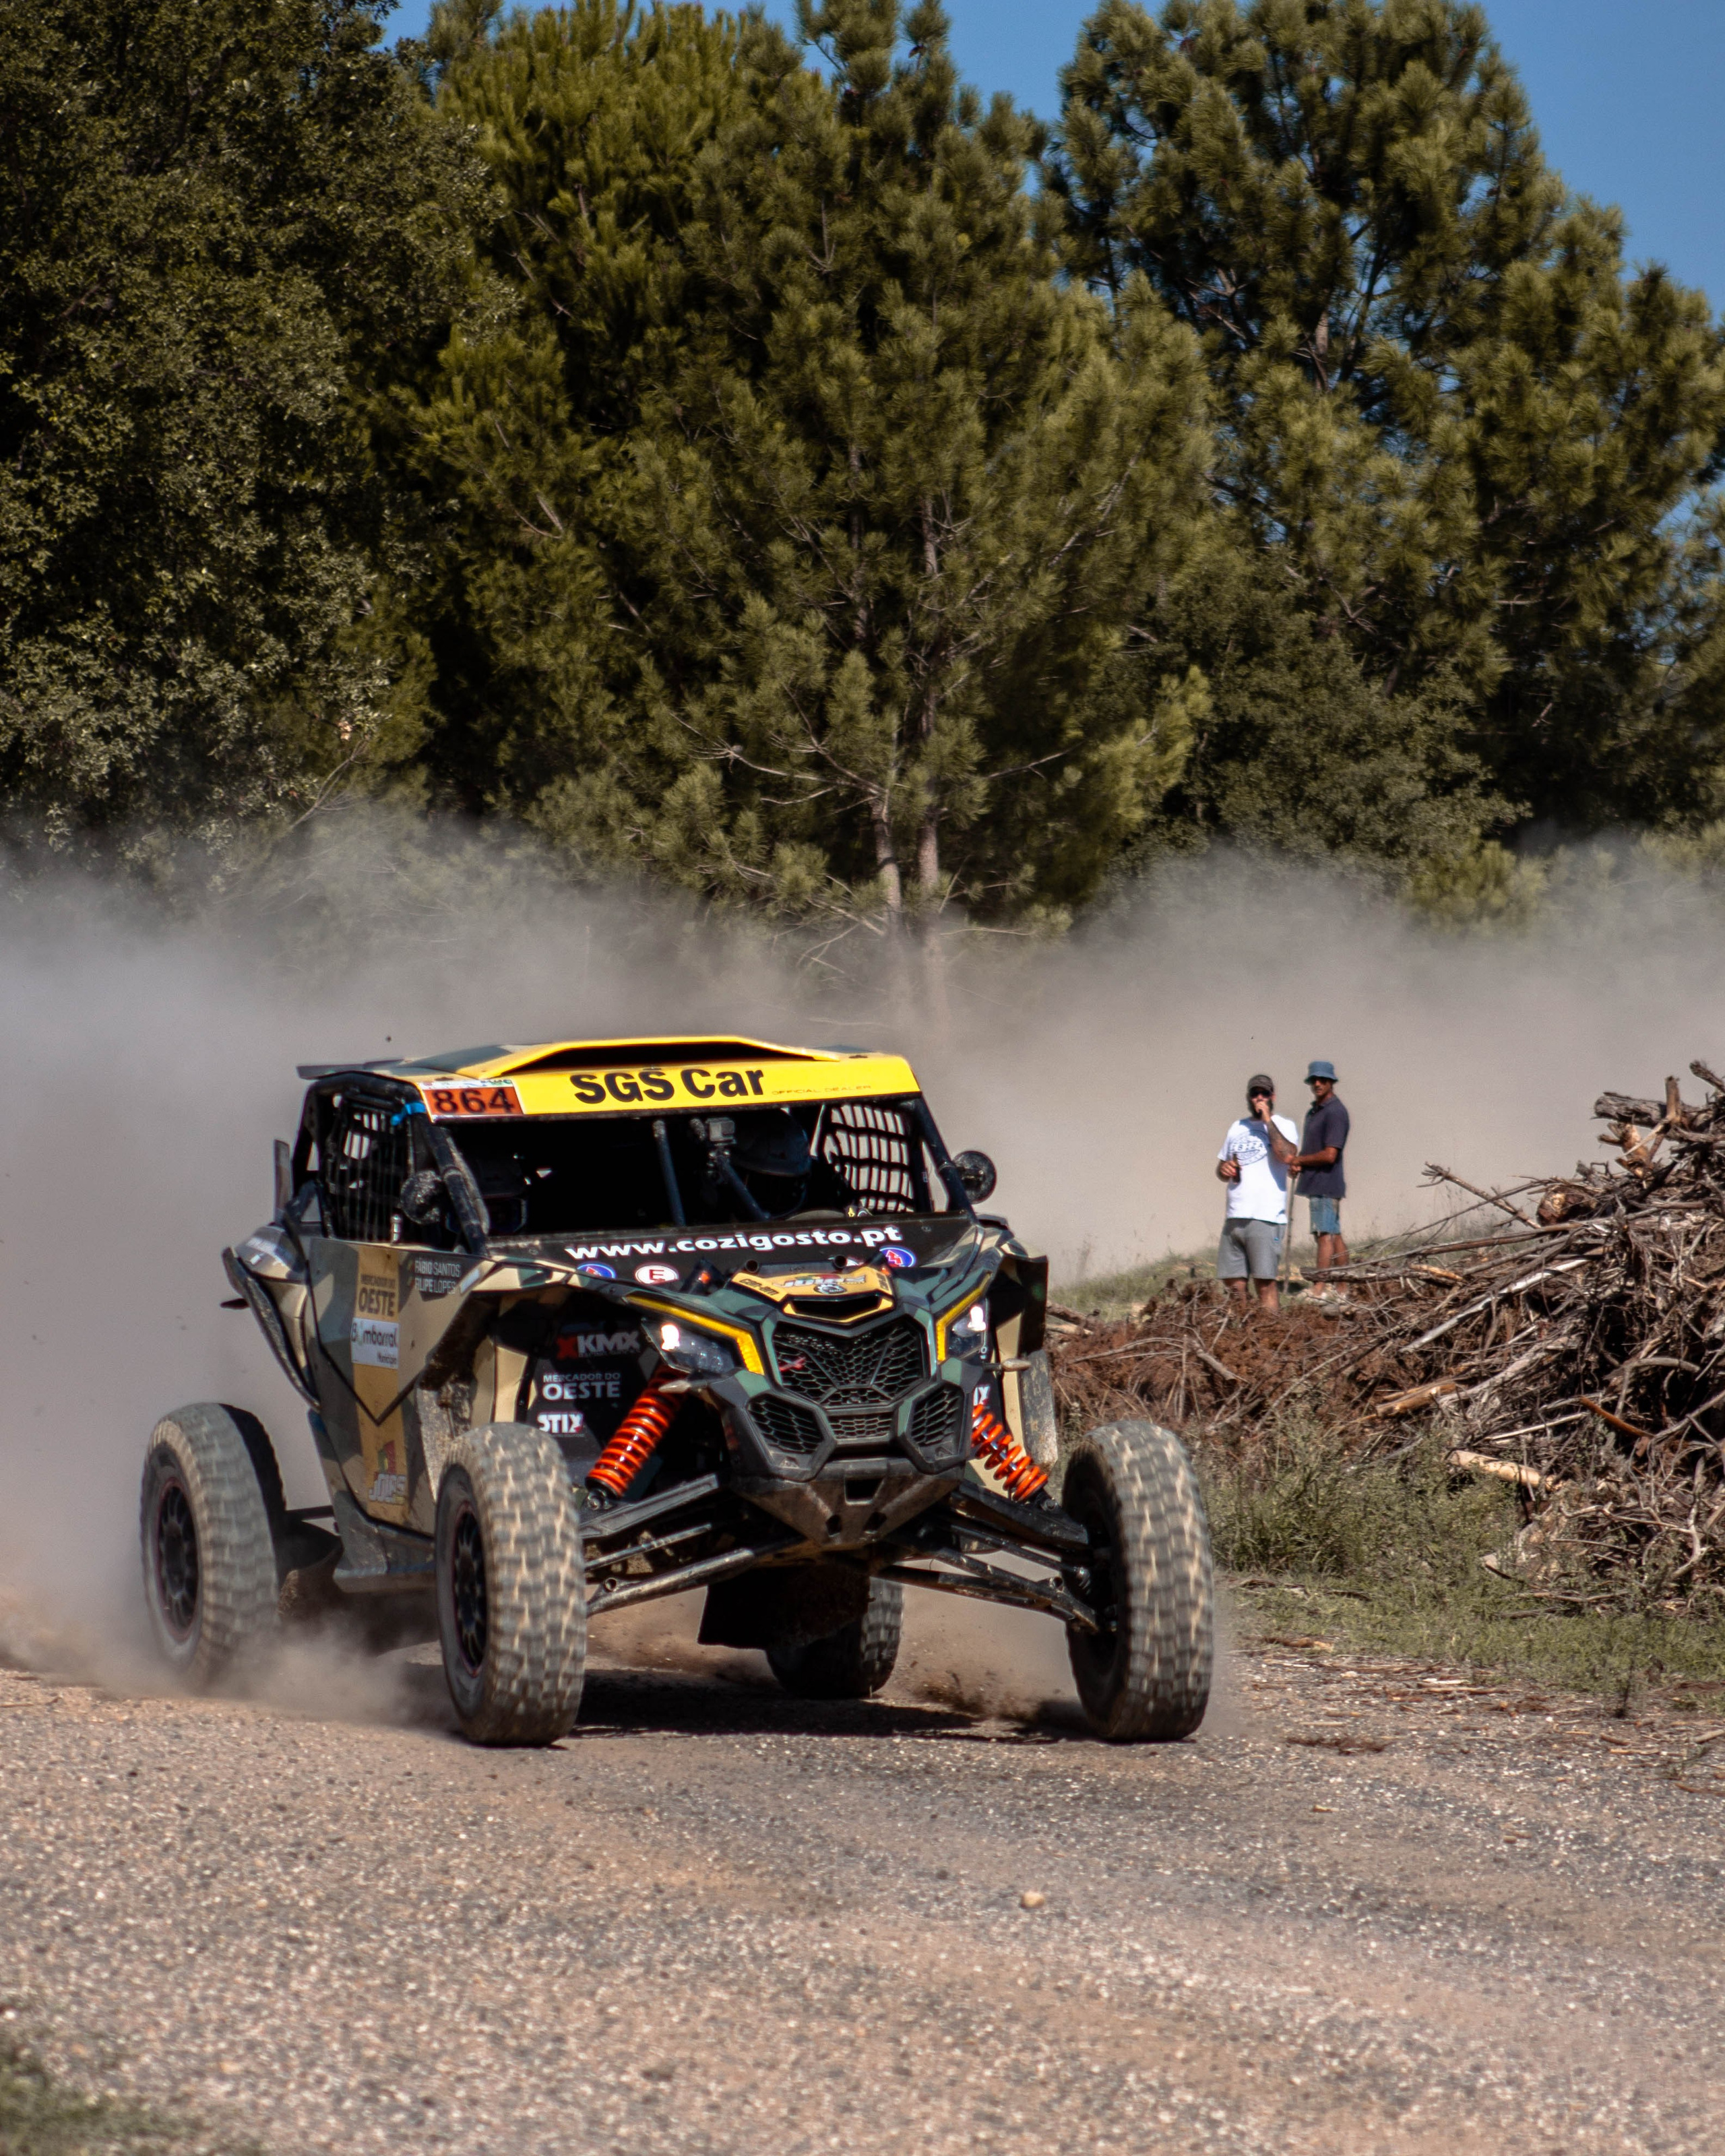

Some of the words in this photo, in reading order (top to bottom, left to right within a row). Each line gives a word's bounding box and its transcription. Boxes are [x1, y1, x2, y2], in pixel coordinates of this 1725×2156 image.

[570, 1070, 675, 1104] SGS
[680, 1068, 765, 1099] Car
[432, 1087, 514, 1116] 864
[565, 1225, 904, 1260] www.cozigosto.pt
[433, 1261, 462, 1277] SANTOS
[434, 1279, 456, 1295] LOPES
[358, 1287, 396, 1317] OESTE
[351, 1322, 398, 1348] Bmbarral
[543, 1372, 602, 1383] MERCADOR
[604, 1372, 621, 1381] DO
[542, 1381, 621, 1401] OESTE
[537, 1412, 584, 1434] STIX
